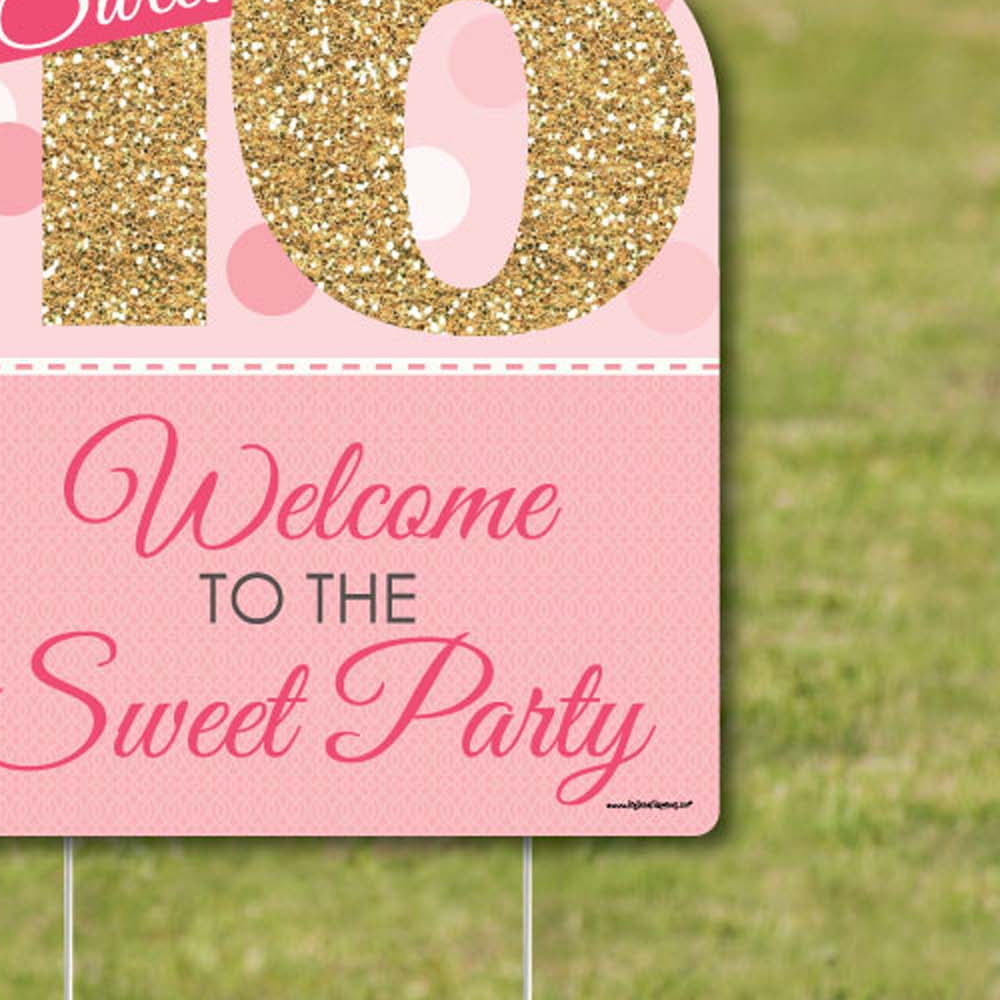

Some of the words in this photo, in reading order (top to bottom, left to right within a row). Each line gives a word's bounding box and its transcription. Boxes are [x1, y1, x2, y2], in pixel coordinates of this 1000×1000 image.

[62, 412, 563, 560] Welcome
[199, 572, 285, 625] TO
[306, 572, 417, 625] THE
[324, 630, 658, 807] Party
